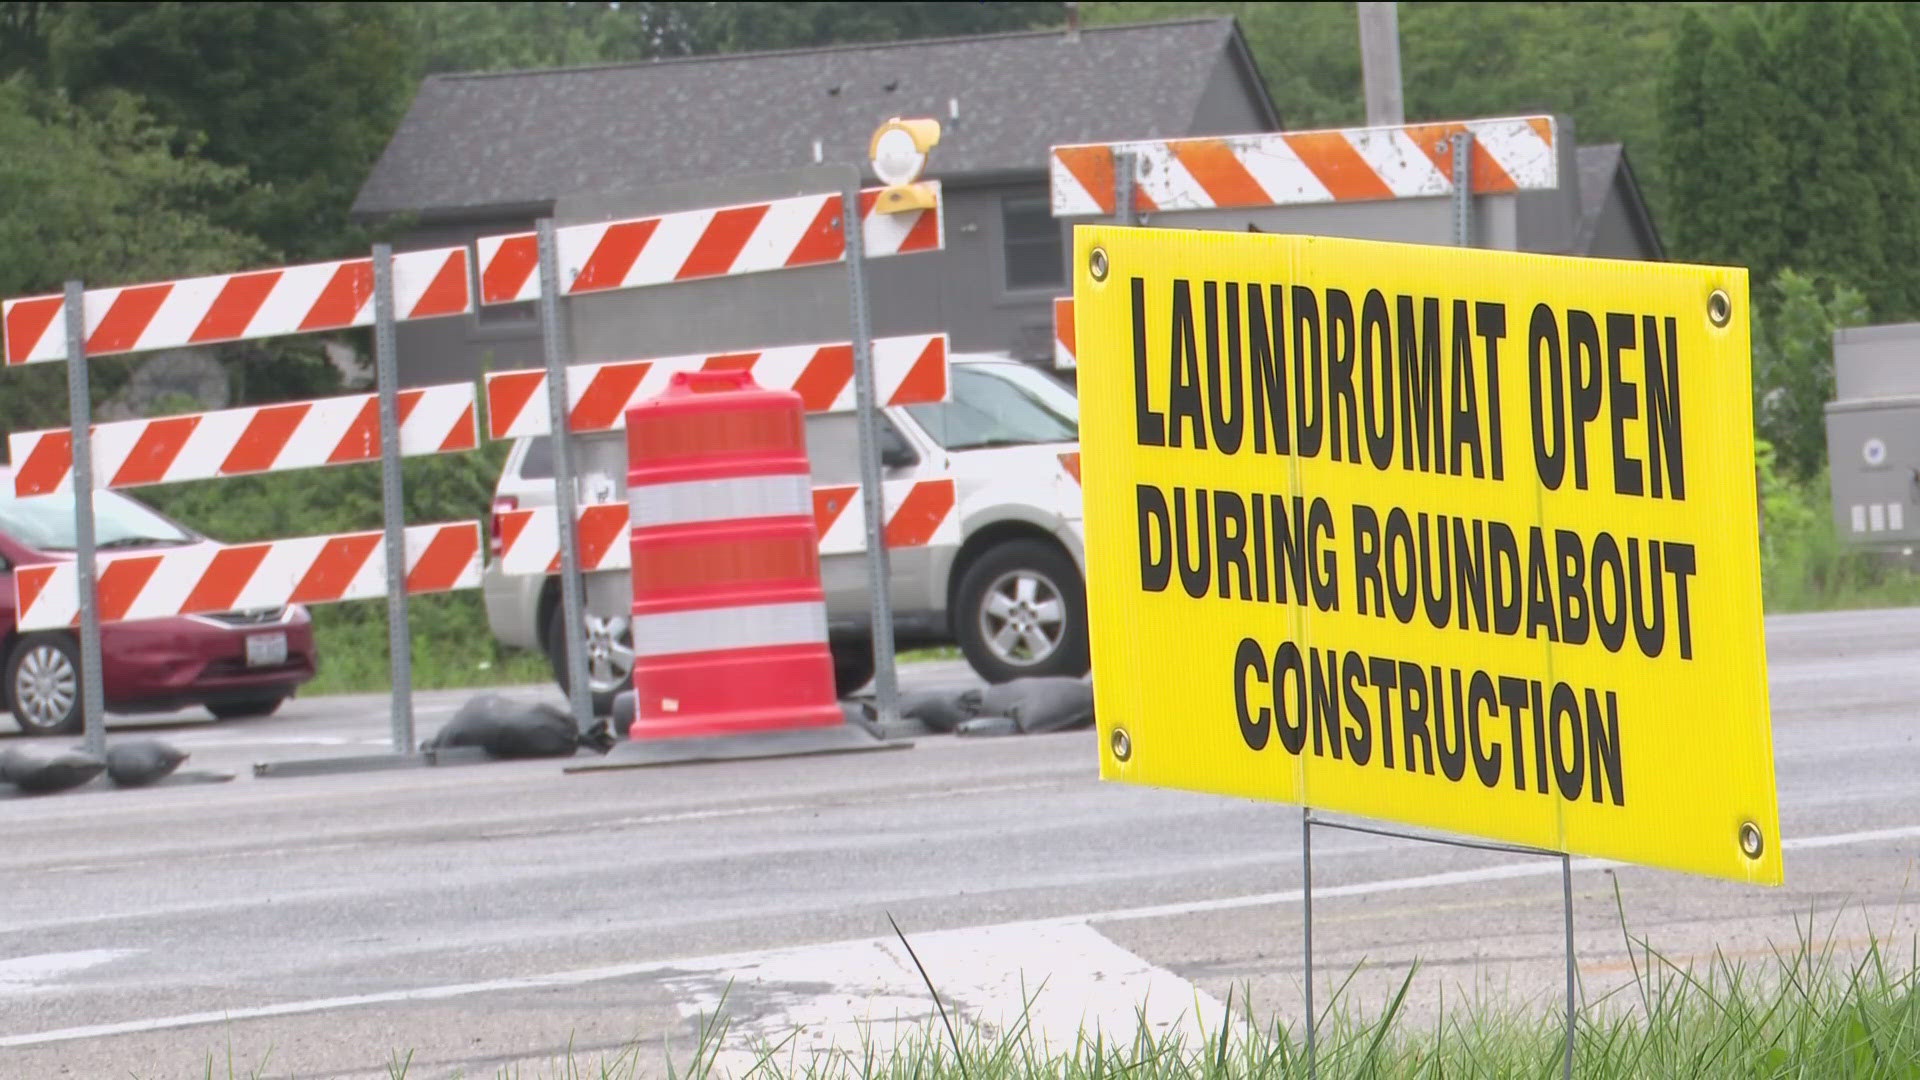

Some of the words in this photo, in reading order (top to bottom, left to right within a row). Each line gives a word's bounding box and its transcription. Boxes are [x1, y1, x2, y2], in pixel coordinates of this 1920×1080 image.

[1130, 277, 1507, 481] LAUNDROMAT
[1528, 302, 1686, 501] OPEN
[1136, 484, 1340, 612] DURING
[1352, 504, 1697, 661] ROUNDABOUT
[1233, 637, 1625, 807] CONSTRUCTION
